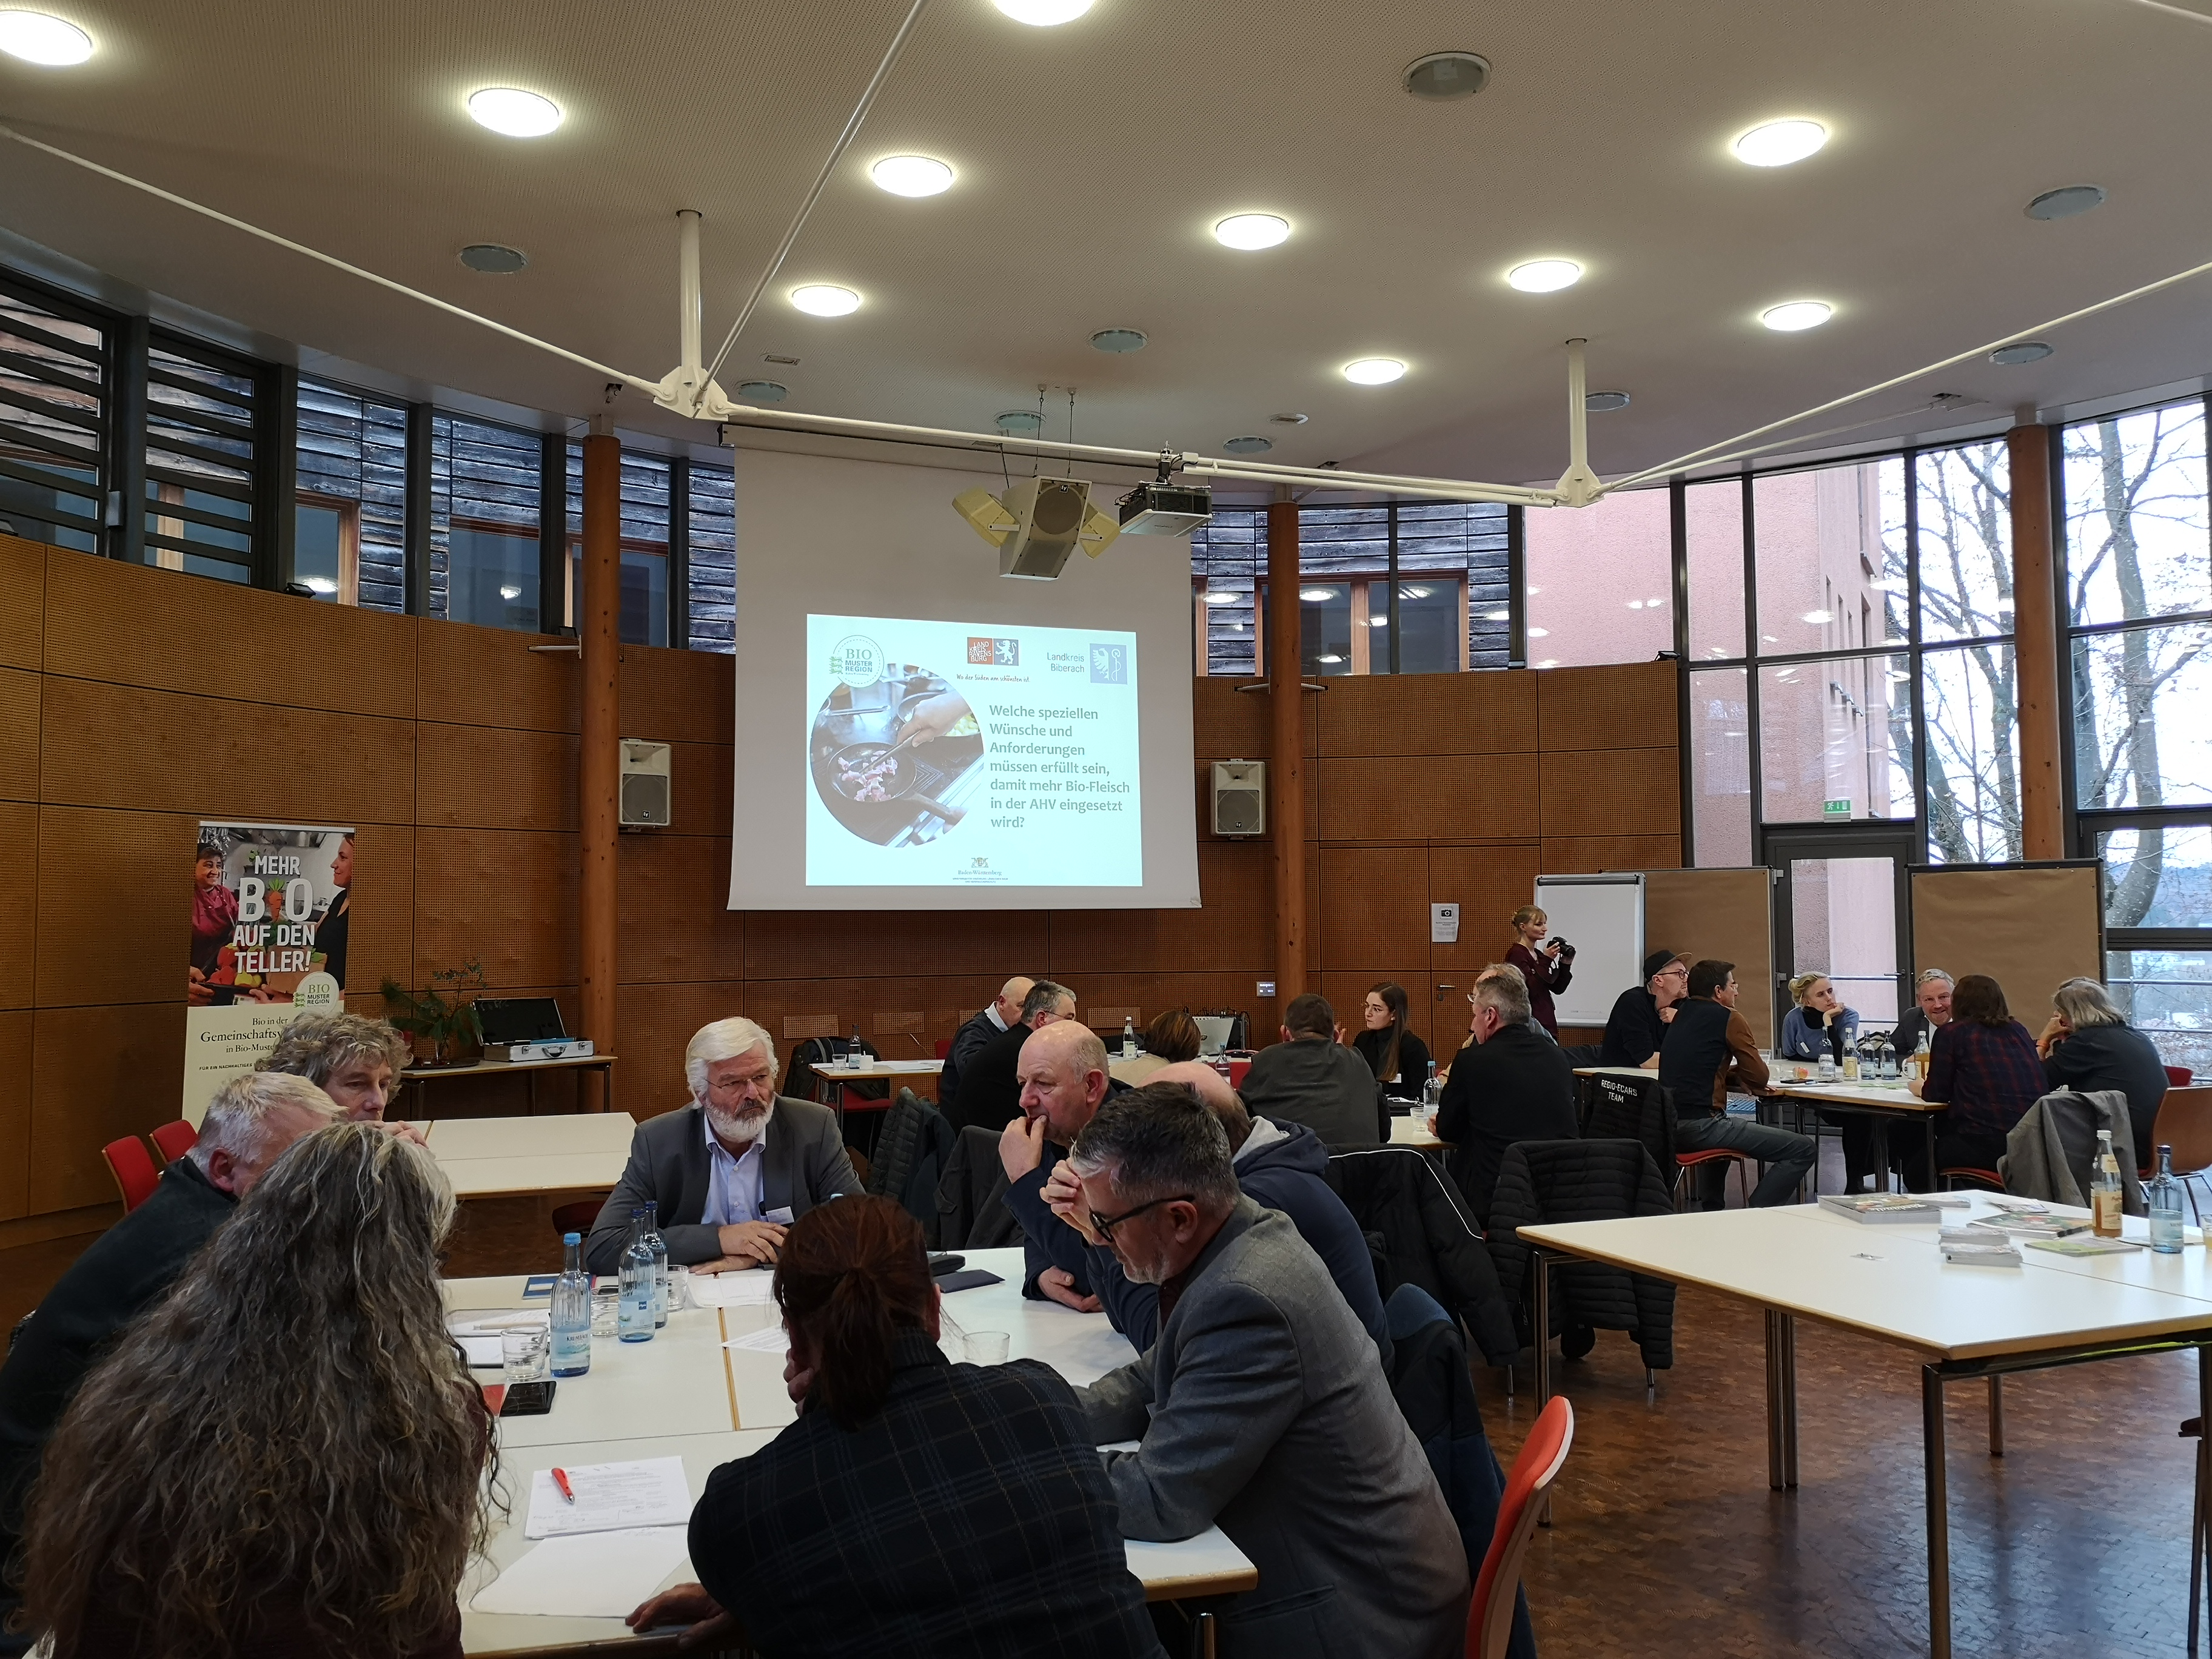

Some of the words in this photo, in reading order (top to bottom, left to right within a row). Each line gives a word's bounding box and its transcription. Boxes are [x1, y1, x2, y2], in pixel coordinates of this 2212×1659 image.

[845, 648, 872, 660] BIO
[1047, 652, 1085, 662] Landkreis
[1051, 663, 1085, 672] Biberach
[989, 705, 1035, 717] Welche
[1038, 707, 1099, 720] speziellen
[990, 723, 1046, 736] Wünsche
[1049, 725, 1073, 737] und
[990, 742, 1085, 758] Anforderungen
[990, 760, 1037, 773] müssen
[1041, 761, 1079, 774] erfüllt
[1082, 763, 1110, 777] sein,
[990, 779, 1027, 791] damit
[1030, 780, 1062, 791] mehr
[1066, 780, 1130, 793] Bio-Fleisch
[991, 797, 1002, 809] in
[1005, 797, 1027, 809] der
[1030, 799, 1056, 809] AHV
[1059, 799, 1123, 814] eingesetzt
[991, 816, 1025, 828] wird?
[255, 855, 301, 875] MEHR
[232, 924, 271, 947] AUF
[276, 924, 315, 946] DEN
[234, 951, 312, 974] TELLER!
[308, 984, 330, 994] BIO
[276, 1016, 288, 1025] der
[1601, 1079, 1638, 1096] REGIO-ECARS
[1608, 1091, 1624, 1103] TEAM
